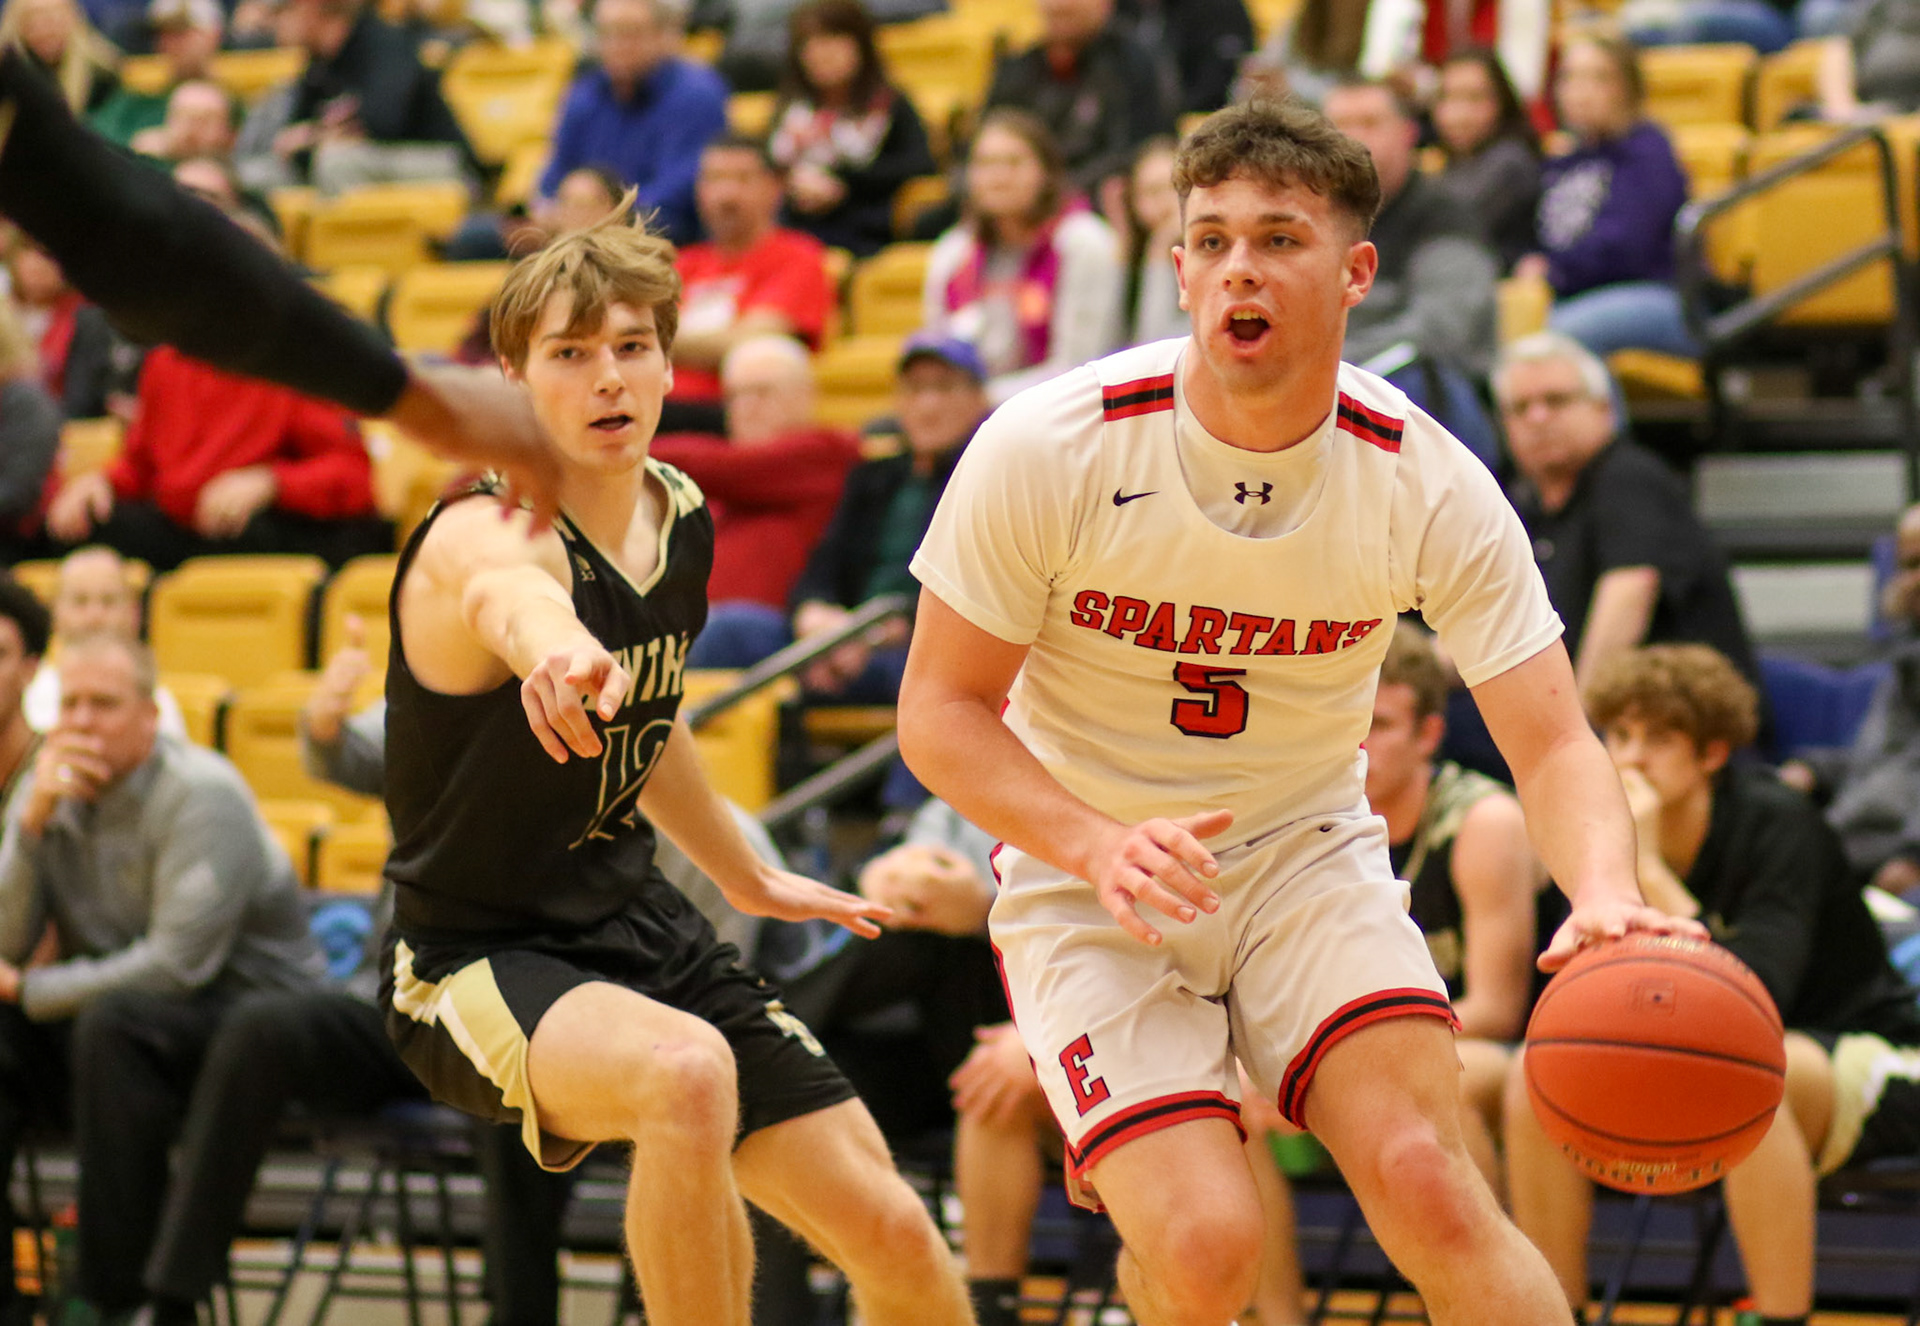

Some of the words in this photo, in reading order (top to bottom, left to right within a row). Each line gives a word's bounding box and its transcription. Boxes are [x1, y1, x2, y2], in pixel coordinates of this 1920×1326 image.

[1070, 589, 1383, 655] SPARTANS
[1170, 661, 1249, 739] 5
[1058, 1032, 1111, 1117] E
